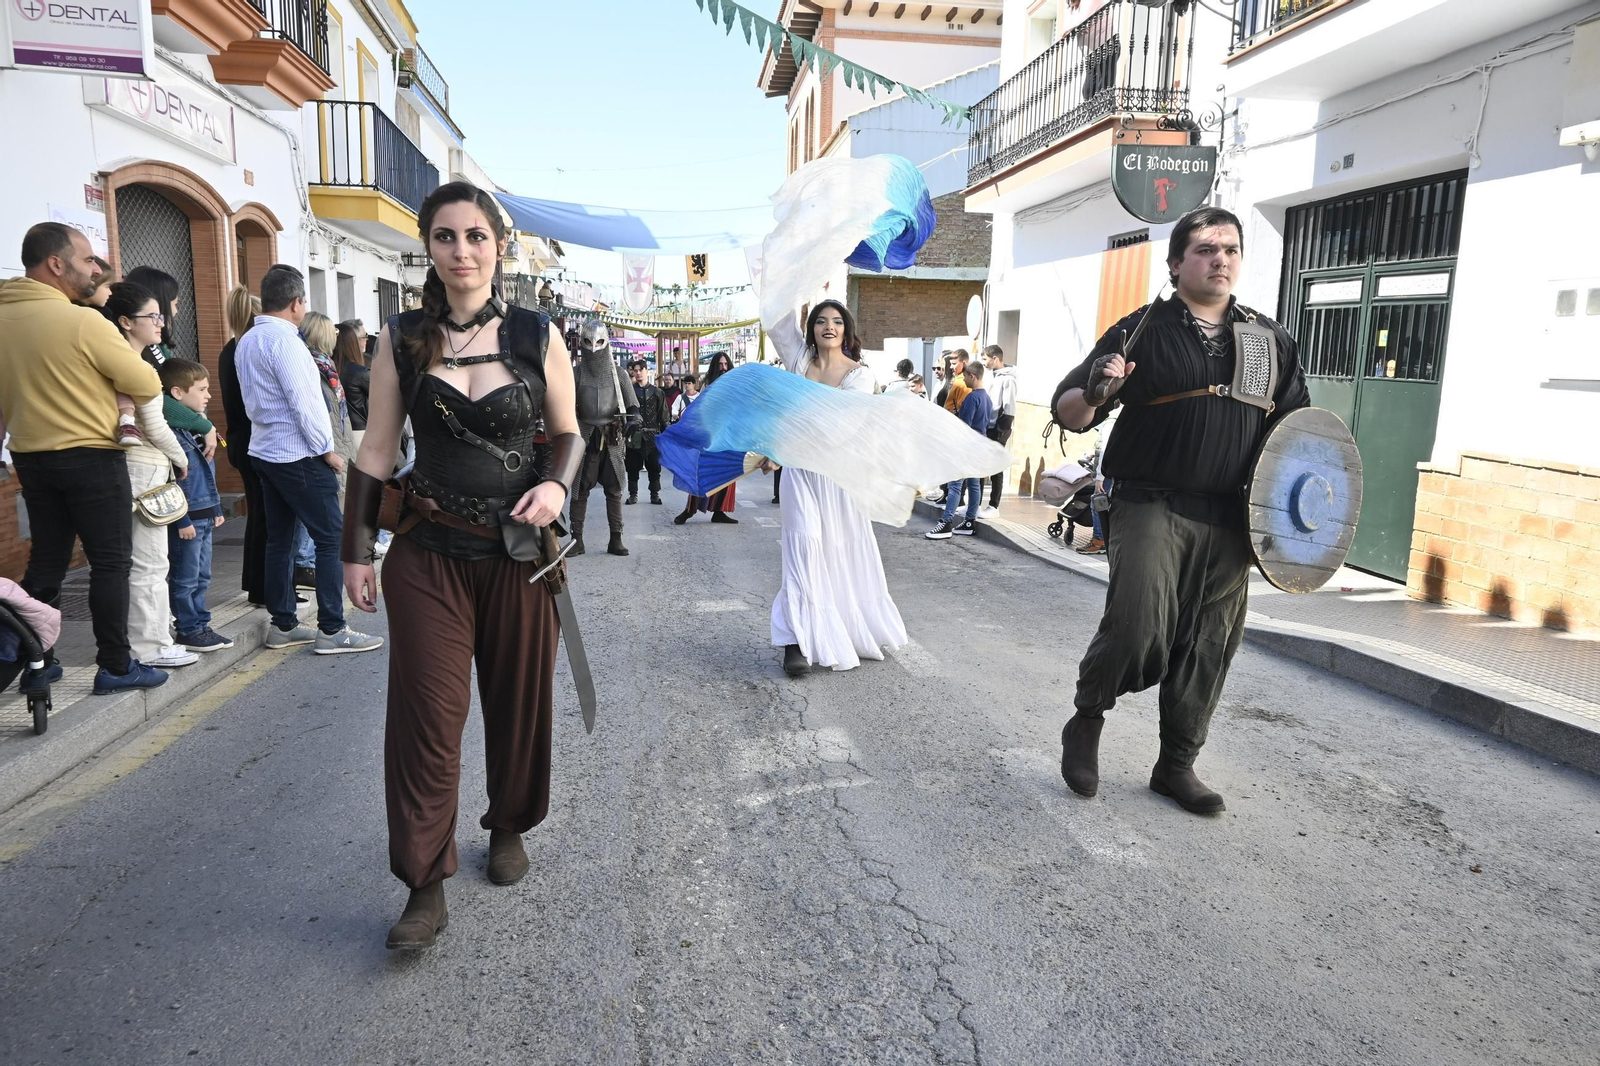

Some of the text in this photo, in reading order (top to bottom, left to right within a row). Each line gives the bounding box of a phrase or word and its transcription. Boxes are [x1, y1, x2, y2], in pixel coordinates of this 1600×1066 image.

[48, 4, 137, 24] DENTAL
[154, 84, 223, 144] DENTAL
[1123, 153, 1209, 174] El Bodegón
